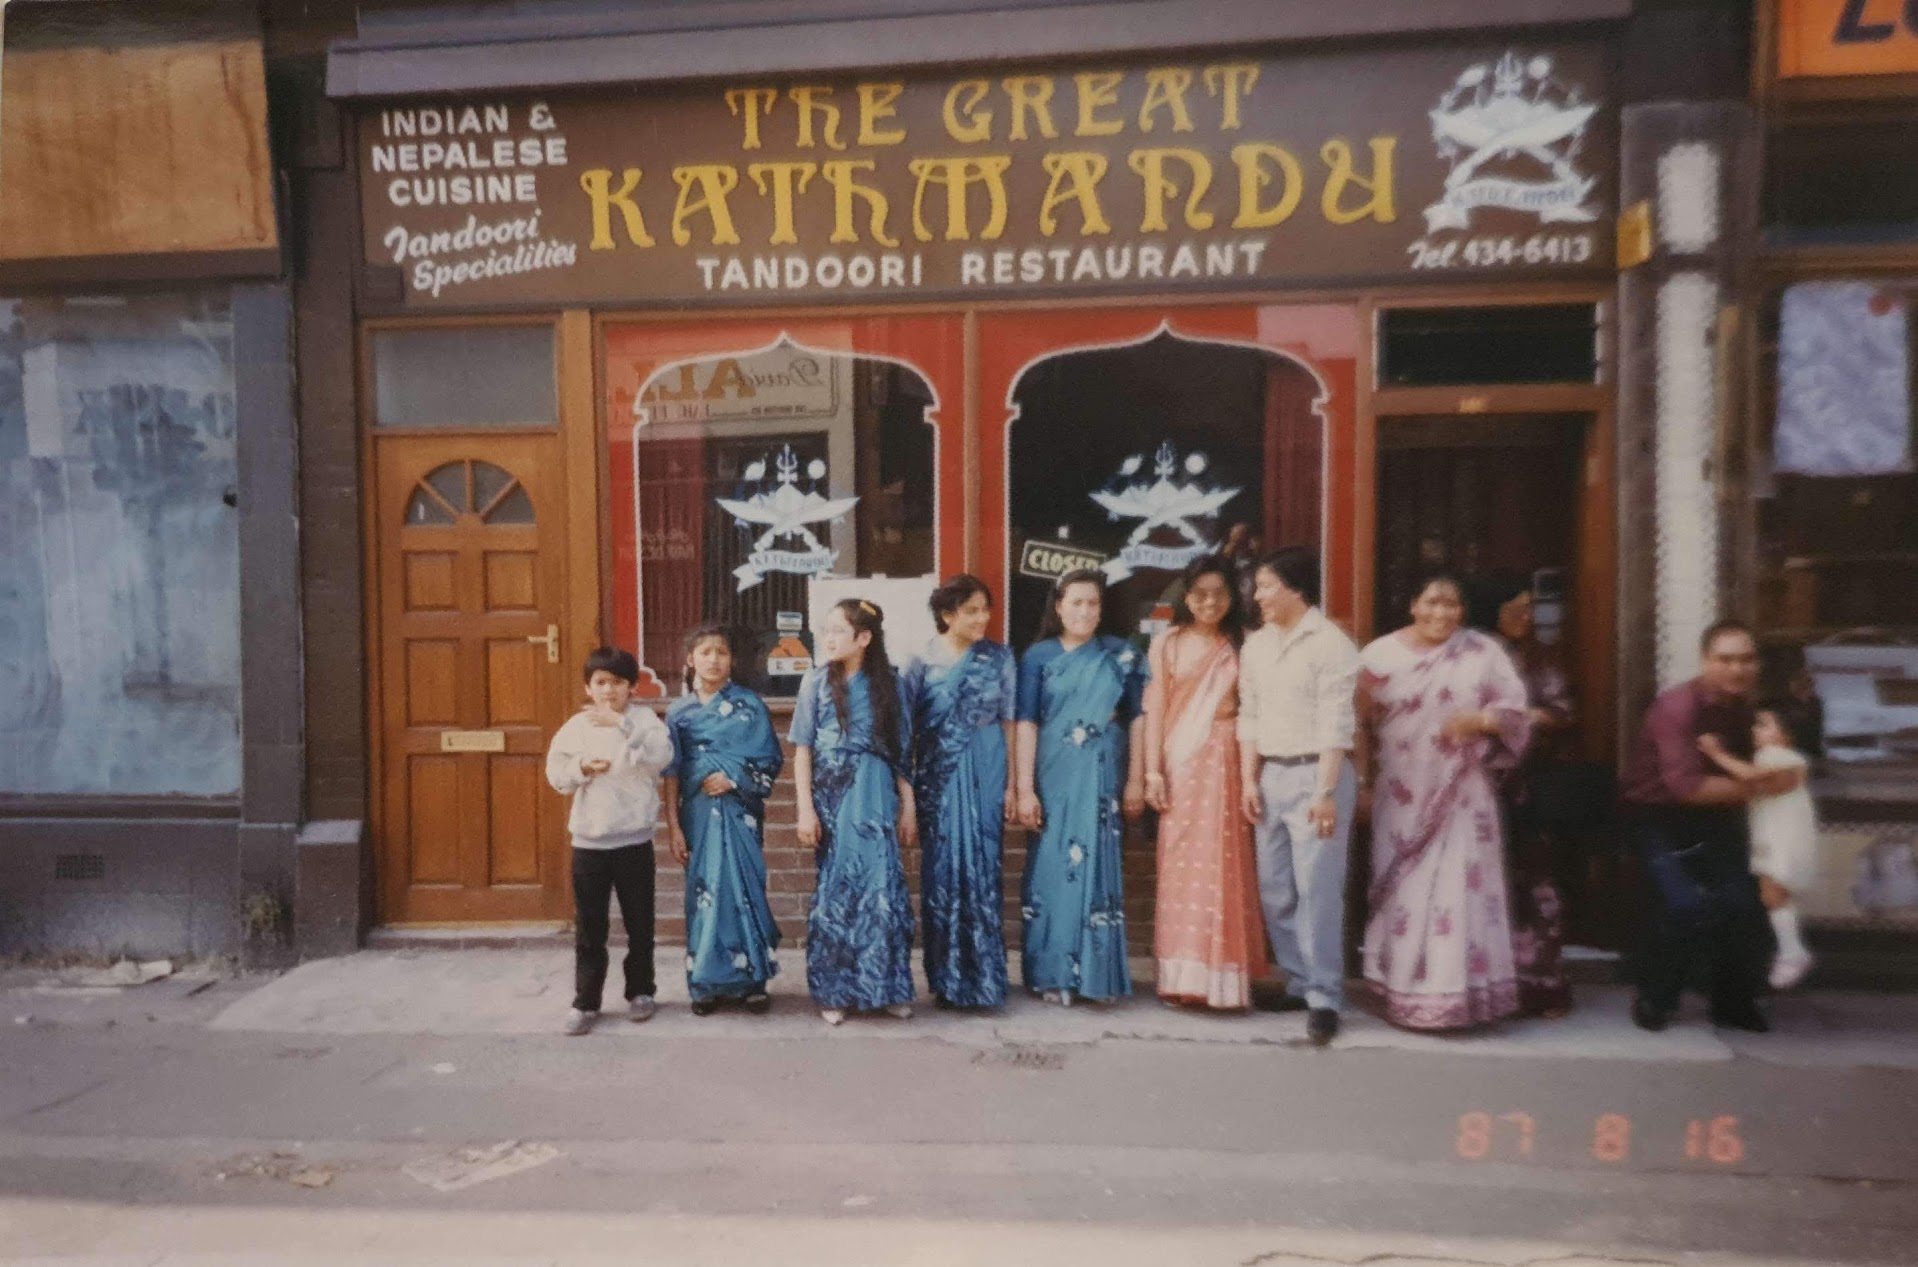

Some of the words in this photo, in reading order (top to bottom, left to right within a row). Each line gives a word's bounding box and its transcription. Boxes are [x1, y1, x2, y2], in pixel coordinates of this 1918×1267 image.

[381, 105, 509, 137] INDIAN
[529, 103, 557, 130] &
[724, 83, 907, 150] THE
[942, 61, 1261, 143] GREAT
[371, 137, 568, 172] NEPALESE
[388, 173, 538, 206] CUISINE
[579, 136, 1397, 250] KATHMANDU
[384, 207, 542, 263] Tandoori
[1464, 235, 1592, 267] 434-6413
[413, 240, 577, 298] Specialities
[696, 254, 923, 292] TANDOORI
[961, 241, 1267, 286] RESTAURANT
